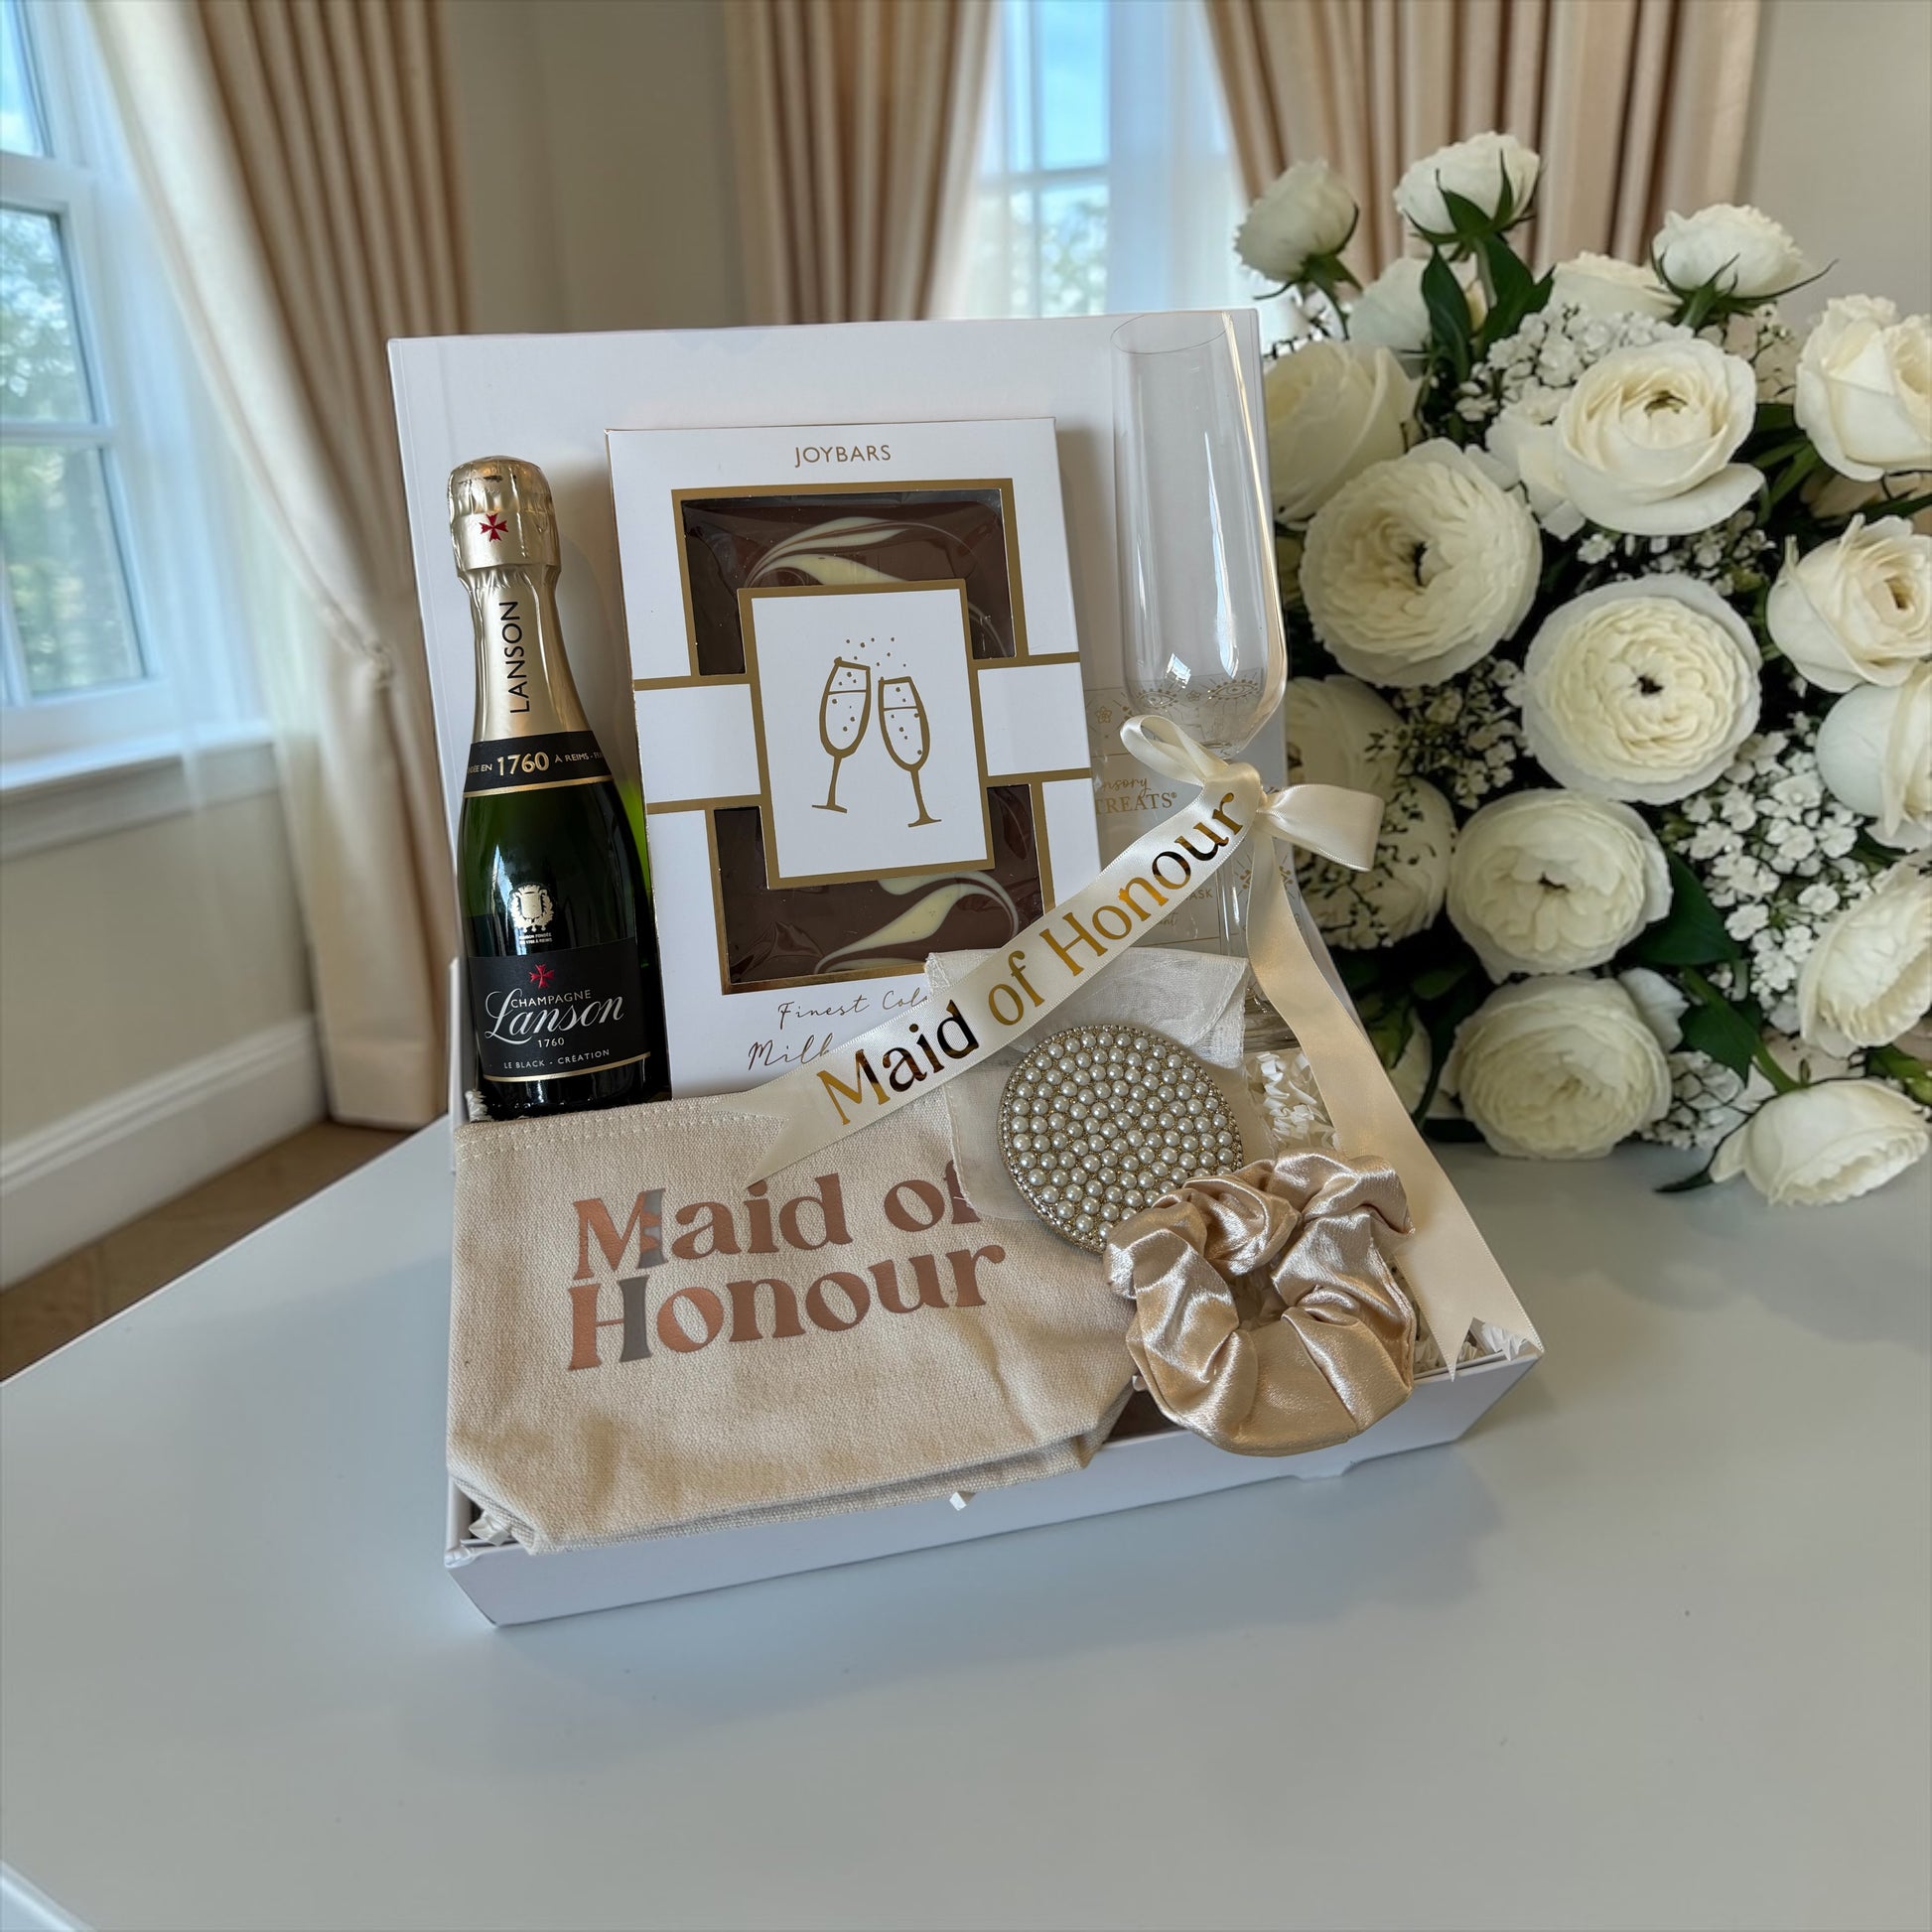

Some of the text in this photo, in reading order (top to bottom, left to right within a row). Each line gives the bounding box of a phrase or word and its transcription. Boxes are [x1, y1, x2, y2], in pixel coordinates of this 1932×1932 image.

[794, 444, 892, 469] JOYBARS
[498, 601, 530, 714] LANSON
[481, 762, 493, 772] EN
[496, 751, 550, 776] 1760
[564, 753, 590, 762] REIMS
[1100, 777, 1152, 798] nsory
[1185, 889, 1213, 901] ASK
[816, 791, 1244, 1126] Maid of Honour
[510, 989, 592, 1009] CHAMPAGNE
[483, 988, 624, 1045] Lanson
[777, 994, 870, 1030] Finest
[537, 1036, 565, 1048] 1760
[515, 1058, 545, 1069] BLACK
[557, 1048, 610, 1065] CRÉATION
[572, 1172, 853, 1282] Maid
[567, 1243, 1007, 1372] Honour
